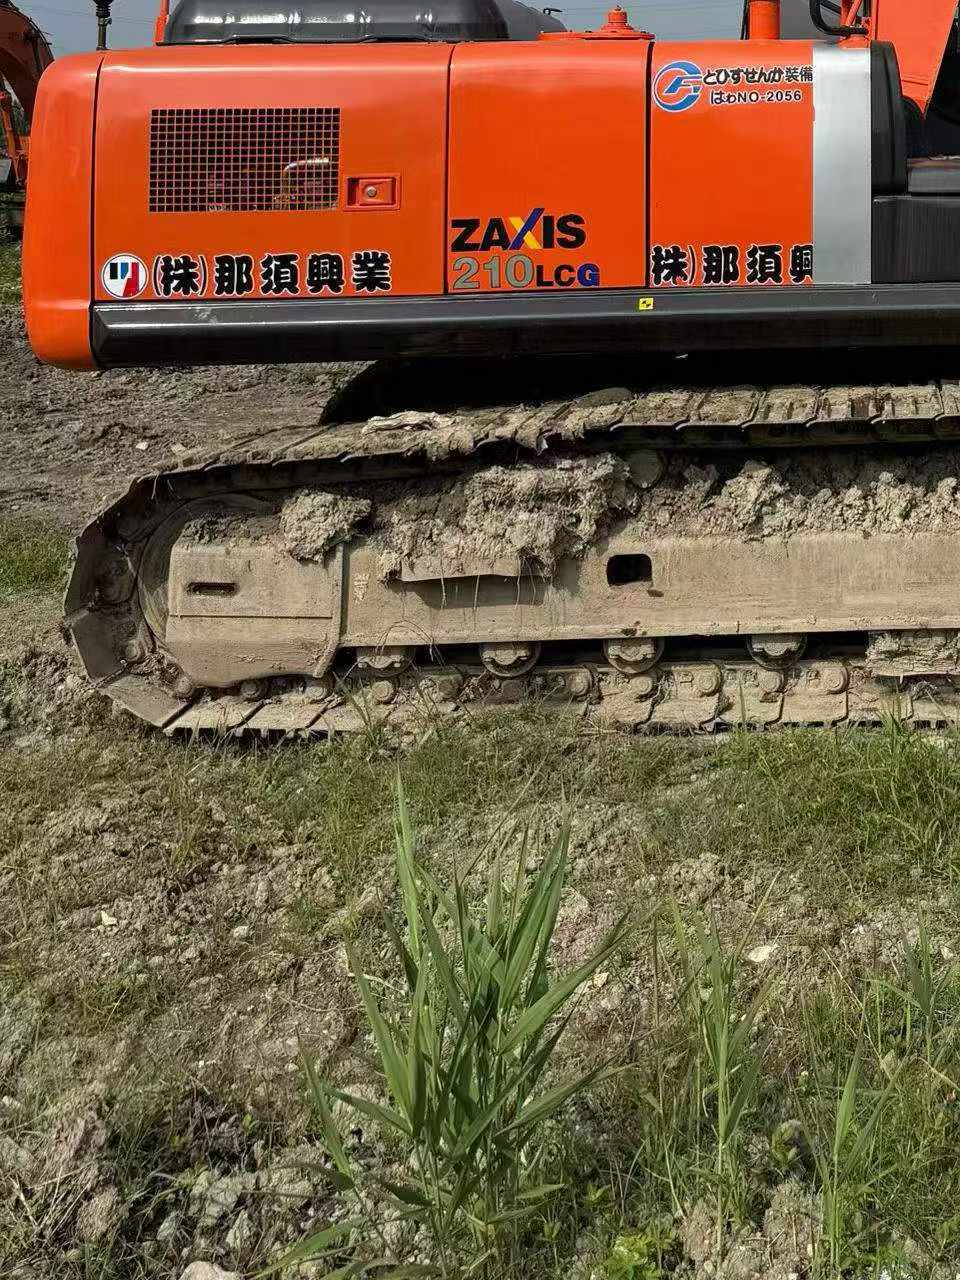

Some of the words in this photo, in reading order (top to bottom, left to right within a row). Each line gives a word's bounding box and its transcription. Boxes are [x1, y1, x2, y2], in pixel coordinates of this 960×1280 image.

[451, 208, 587, 252] ZAXIS
[153, 252, 391, 296] (株)那須興業
[453, 254, 600, 289] 210LCG
